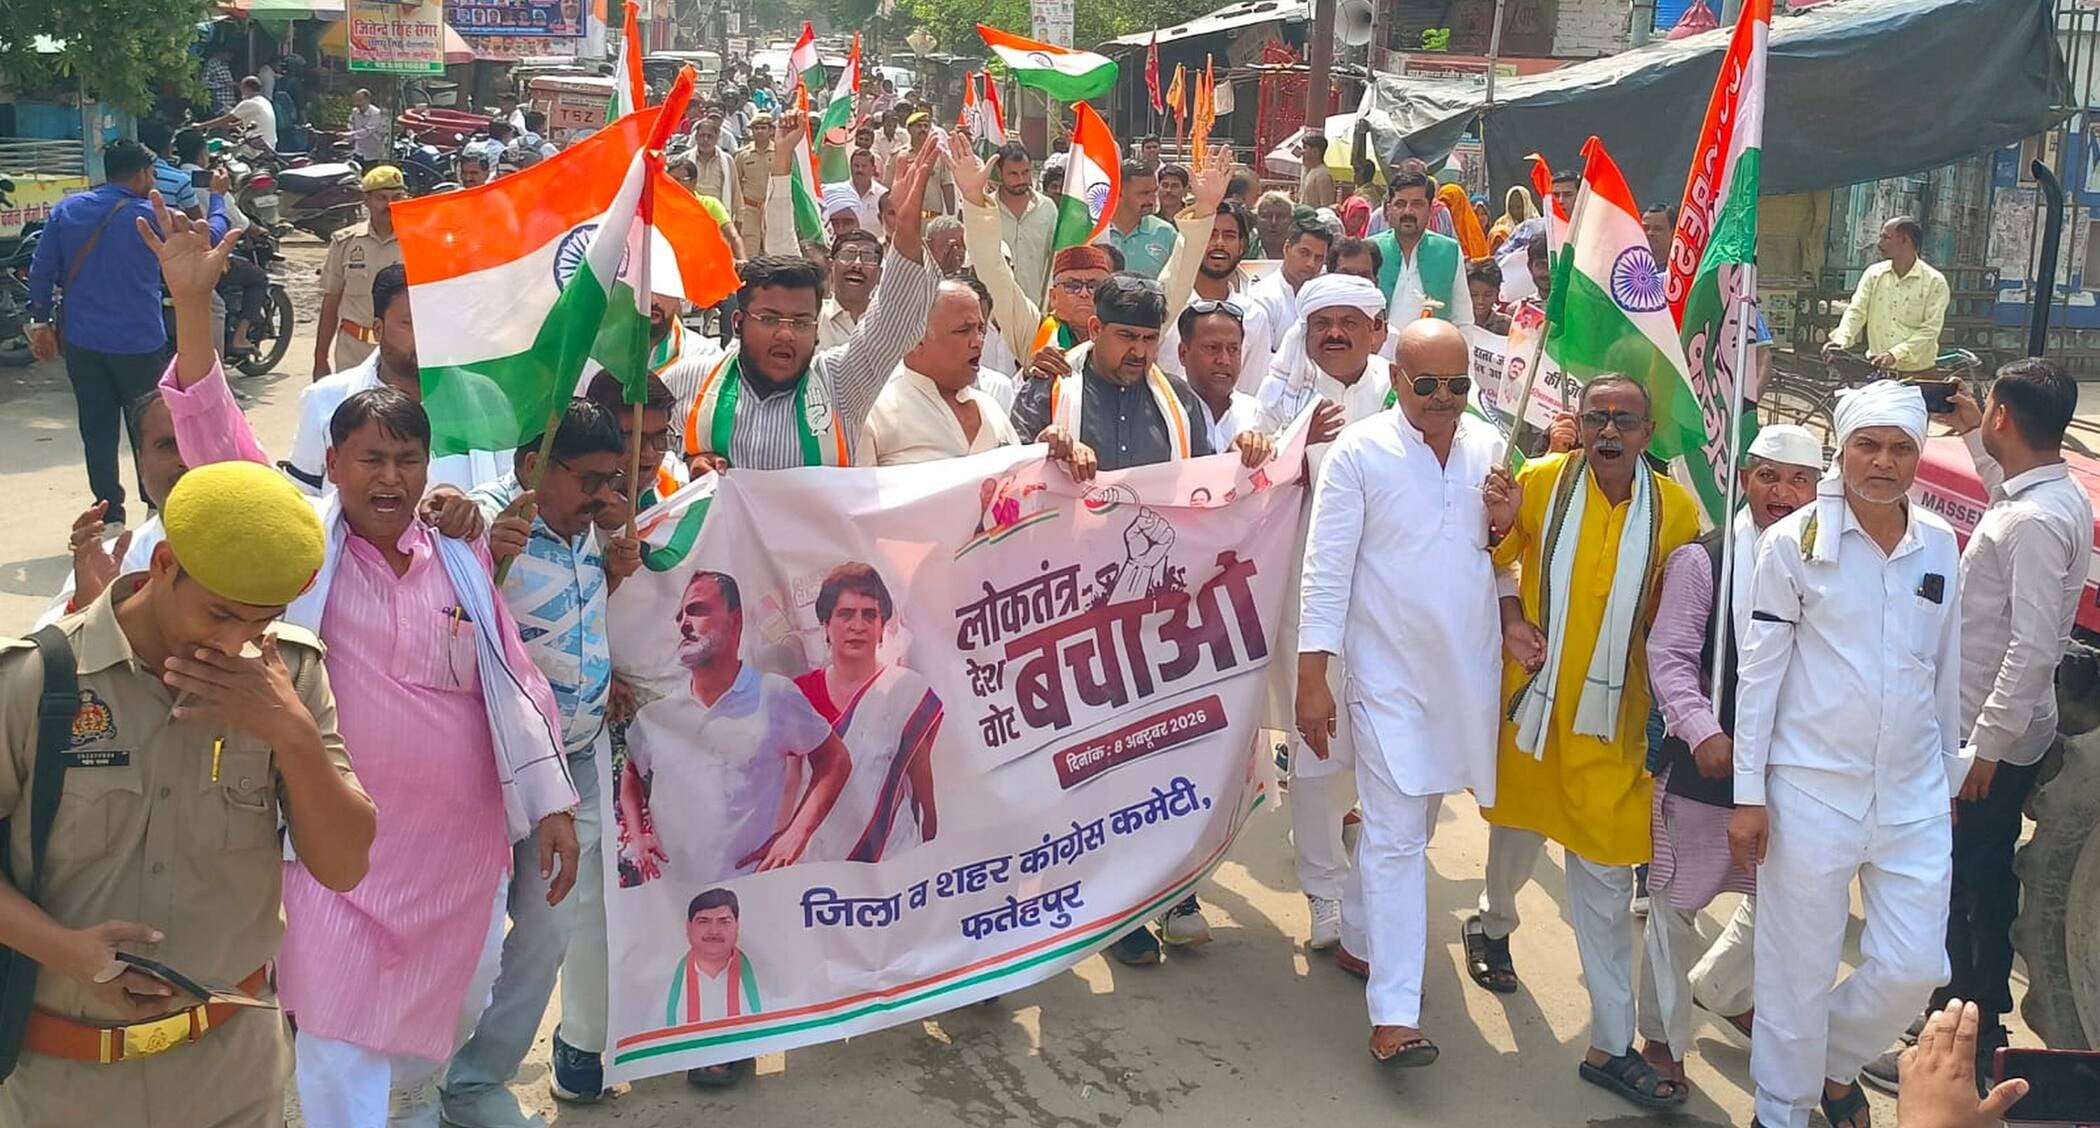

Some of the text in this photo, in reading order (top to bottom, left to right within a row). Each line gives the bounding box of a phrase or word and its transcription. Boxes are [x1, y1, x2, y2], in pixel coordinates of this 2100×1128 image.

[955, 560, 1081, 651] लोकतंत्र
[1004, 550, 1268, 731] बचाओ
[966, 658, 1007, 697] देश
[978, 703, 1021, 748] वोट
[1114, 740, 1124, 754] 8
[1169, 709, 1207, 733] 2026
[800, 776, 1213, 928] जिला व शहर कांग्रेस कमेटी,
[960, 880, 1084, 941] फतेहपुर
